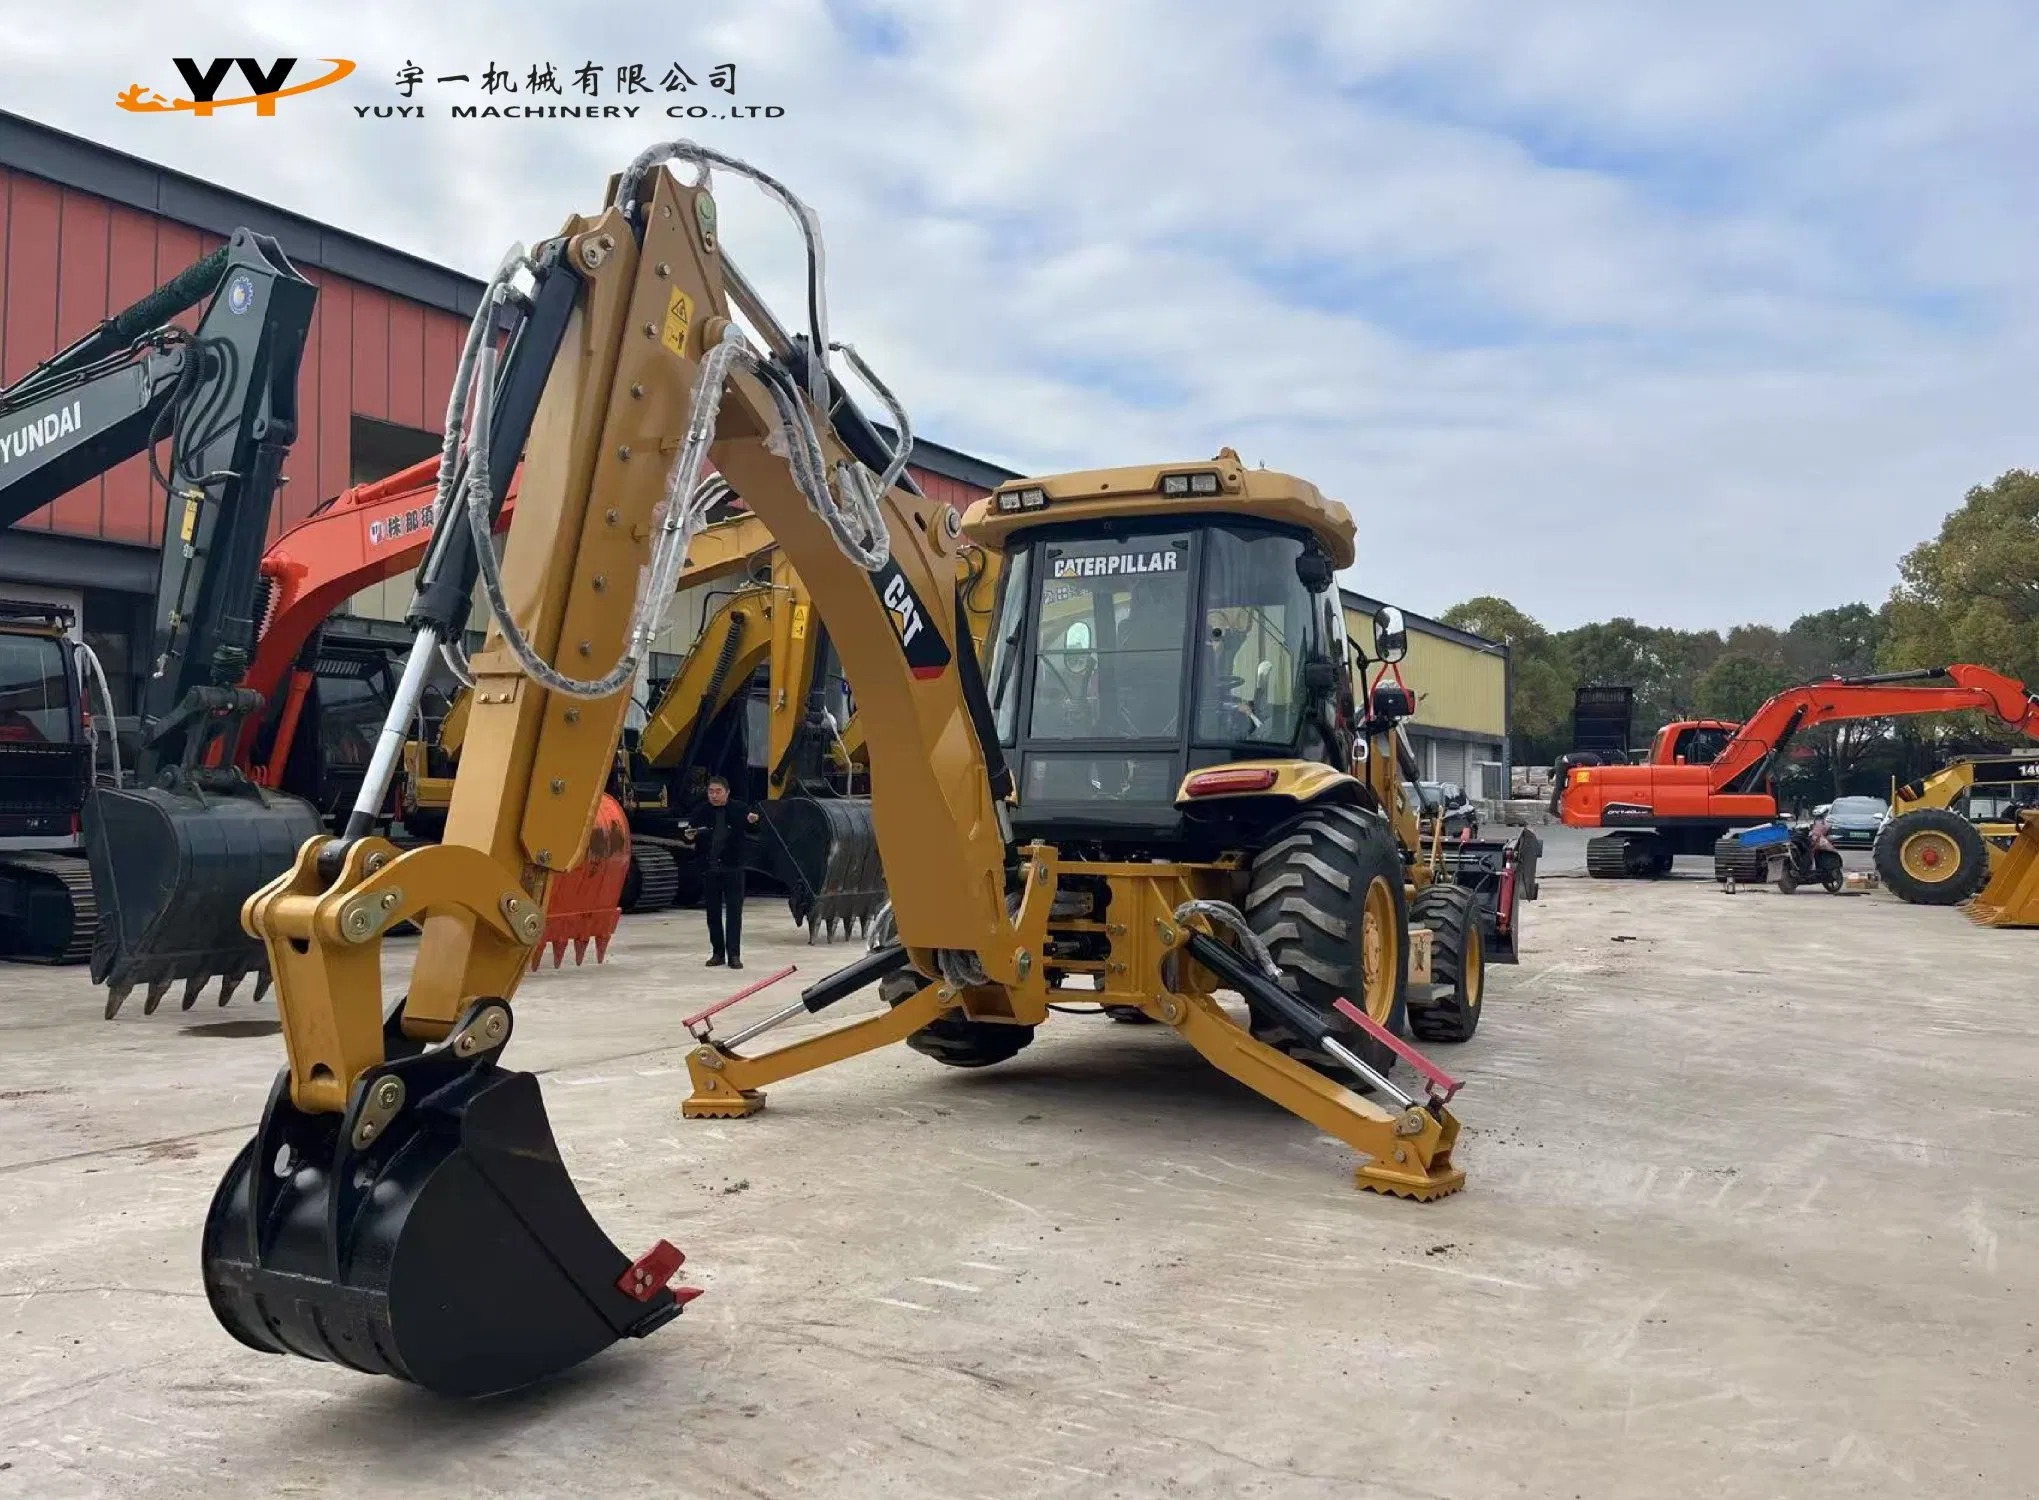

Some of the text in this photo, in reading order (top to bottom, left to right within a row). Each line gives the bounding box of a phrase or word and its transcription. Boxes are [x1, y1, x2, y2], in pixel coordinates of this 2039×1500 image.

[0, 400, 81, 464] YUNDAI
[1054, 551, 1177, 577] CATERPILLAR
[884, 573, 924, 648] CAT
